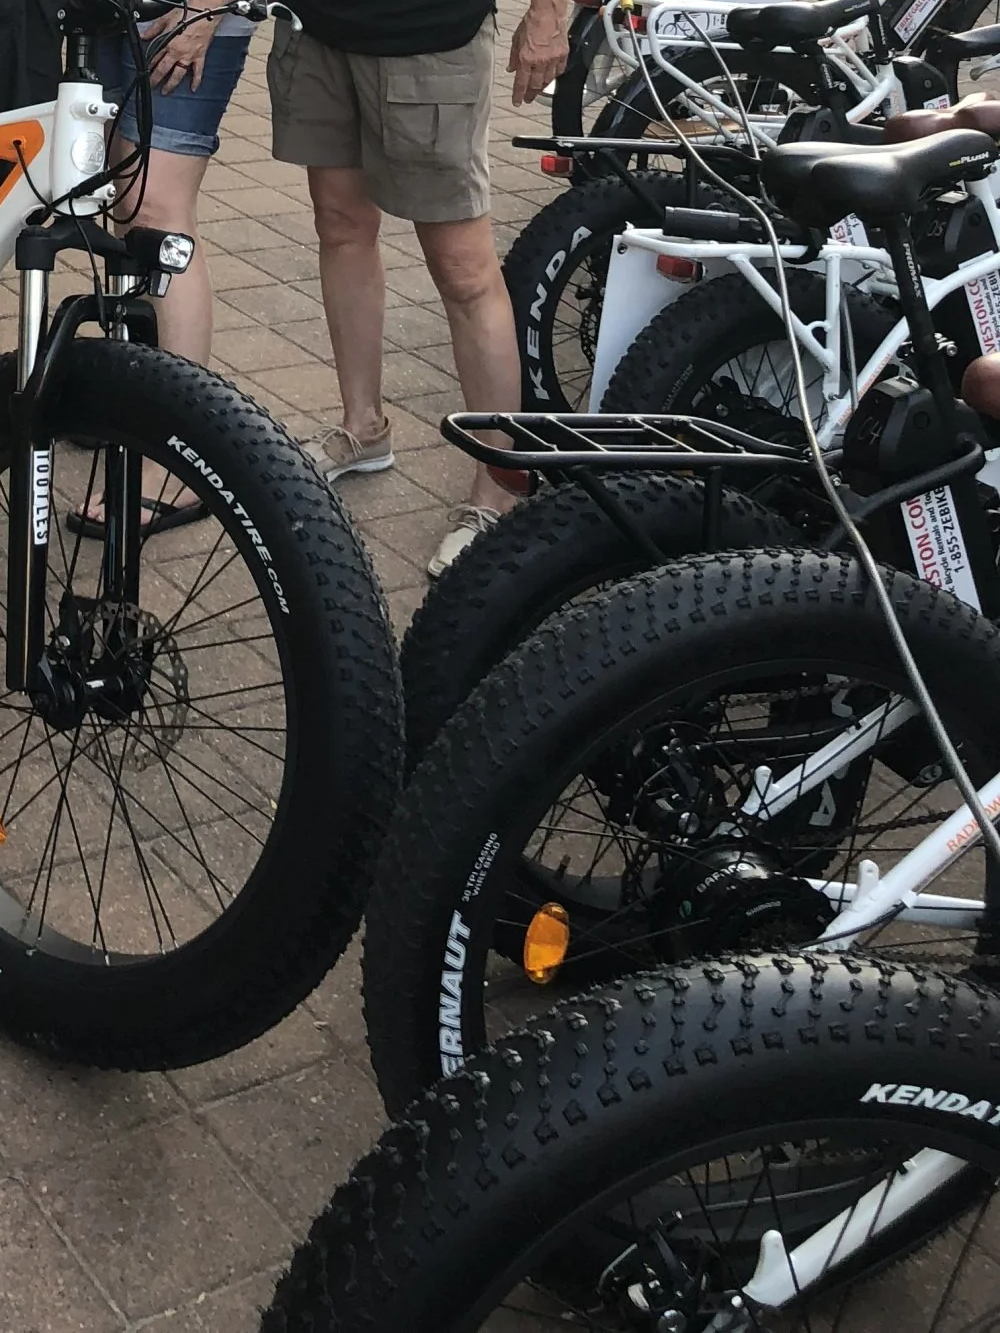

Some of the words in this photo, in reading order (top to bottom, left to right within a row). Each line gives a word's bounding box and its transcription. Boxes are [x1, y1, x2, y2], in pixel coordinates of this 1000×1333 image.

[527, 225, 593, 400] KENDA
[37, 451, 50, 540] TOOTLES
[166, 434, 290, 615] KENDATIRE.COM
[466, 871, 478, 887] TPI
[474, 832, 498, 870] CASING
